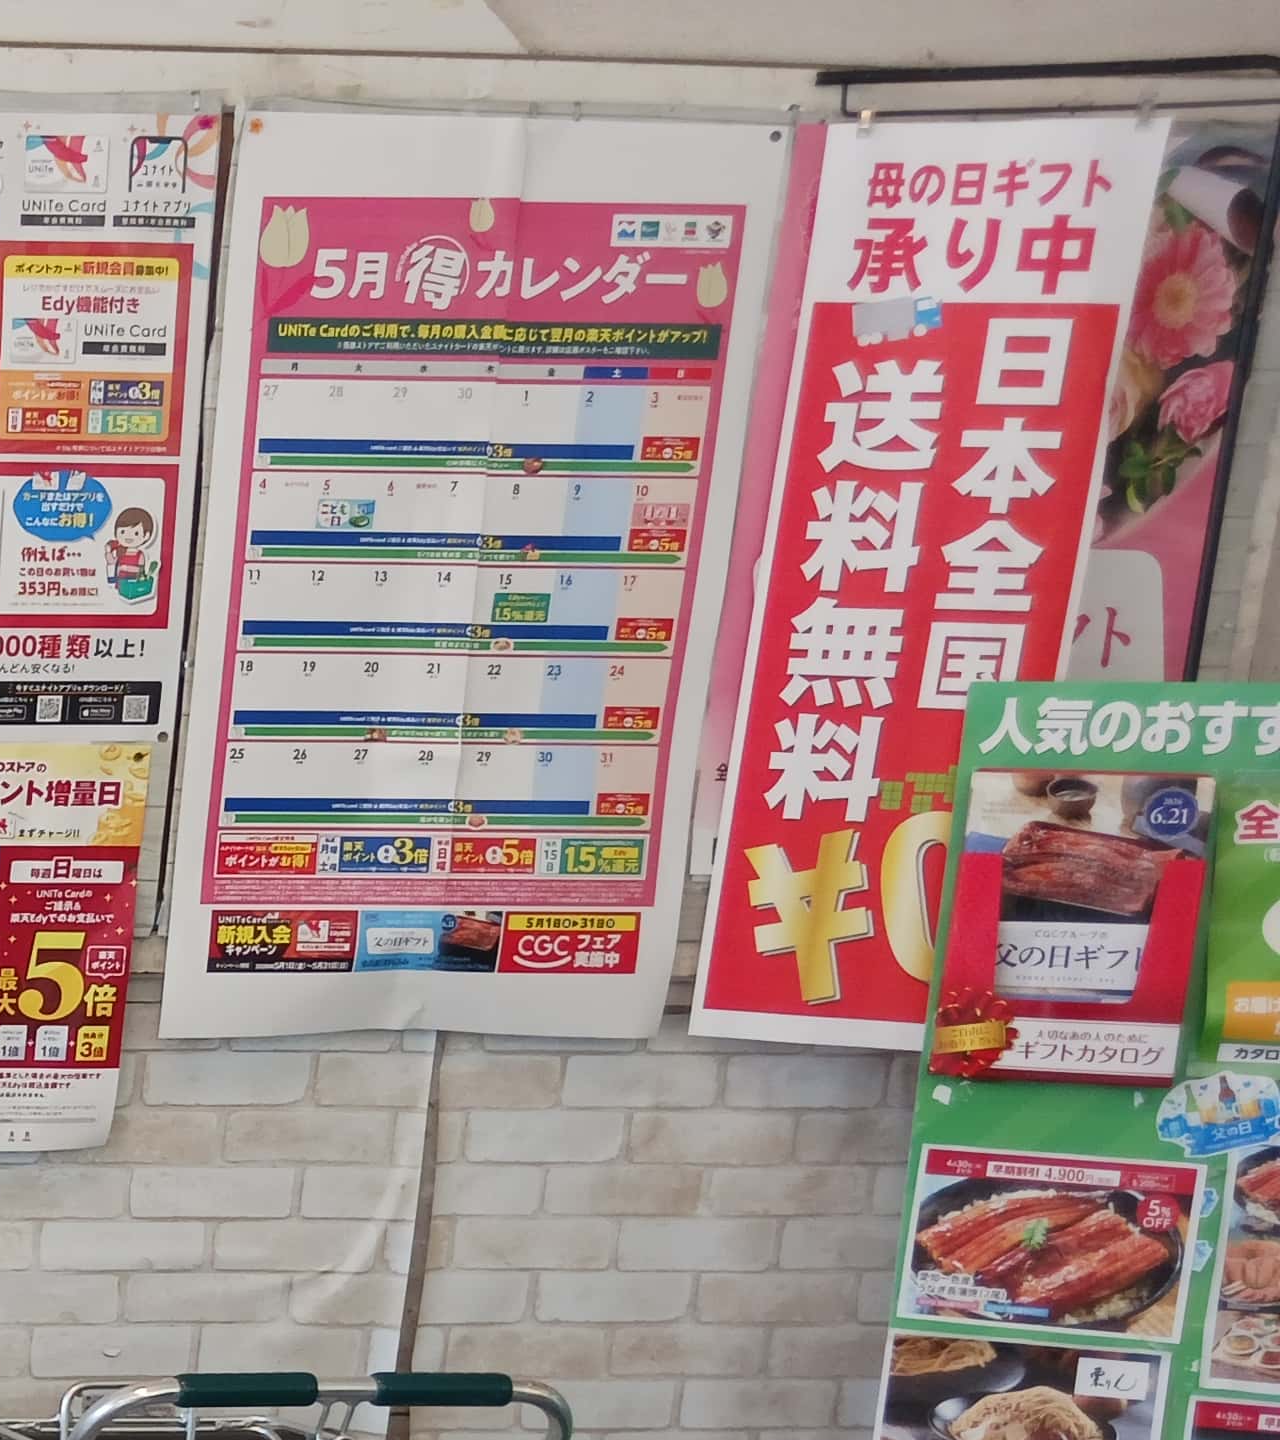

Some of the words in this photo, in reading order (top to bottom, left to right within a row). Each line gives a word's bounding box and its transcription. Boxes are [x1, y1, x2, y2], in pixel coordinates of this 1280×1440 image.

[866, 160, 1113, 208] 母の日ギフト
[21, 200, 64, 214] UNiTe
[69, 200, 107, 214] Card
[121, 199, 191, 215] ユナイトアプリ
[848, 214, 1097, 294] 承り中
[310, 248, 390, 301] 5月
[403, 241, 466, 311] 得
[475, 251, 688, 304] カレンダー
[41, 296, 140, 315] Edy機能付き
[83, 323, 126, 338] UNiTe
[129, 324, 167, 338] Card
[278, 323, 317, 337] UNiTe
[586, 391, 594, 403] 2
[635, 485, 648, 497] 10
[916, 317, 1066, 711] 日本全国
[499, 573, 512, 586] 15
[765, 357, 944, 823] 送料無料
[364, 661, 379, 674] 20
[600, 751, 614, 763] 31
[1149, 807, 1189, 825] 6.21
[30, 857, 103, 880] 毎週日曜日は
[216, 924, 291, 943] 新規入会
[576, 934, 617, 950] フェア
[224, 944, 277, 956] キャンペーン
[517, 935, 568, 957] CGC
[573, 951, 620, 968] 実施中
[17, 931, 86, 1021] 5
[83, 984, 117, 1017] 倍
[1016, 1042, 1166, 1067] ギフトカタログ
[1142, 1216, 1171, 1229] OFF
